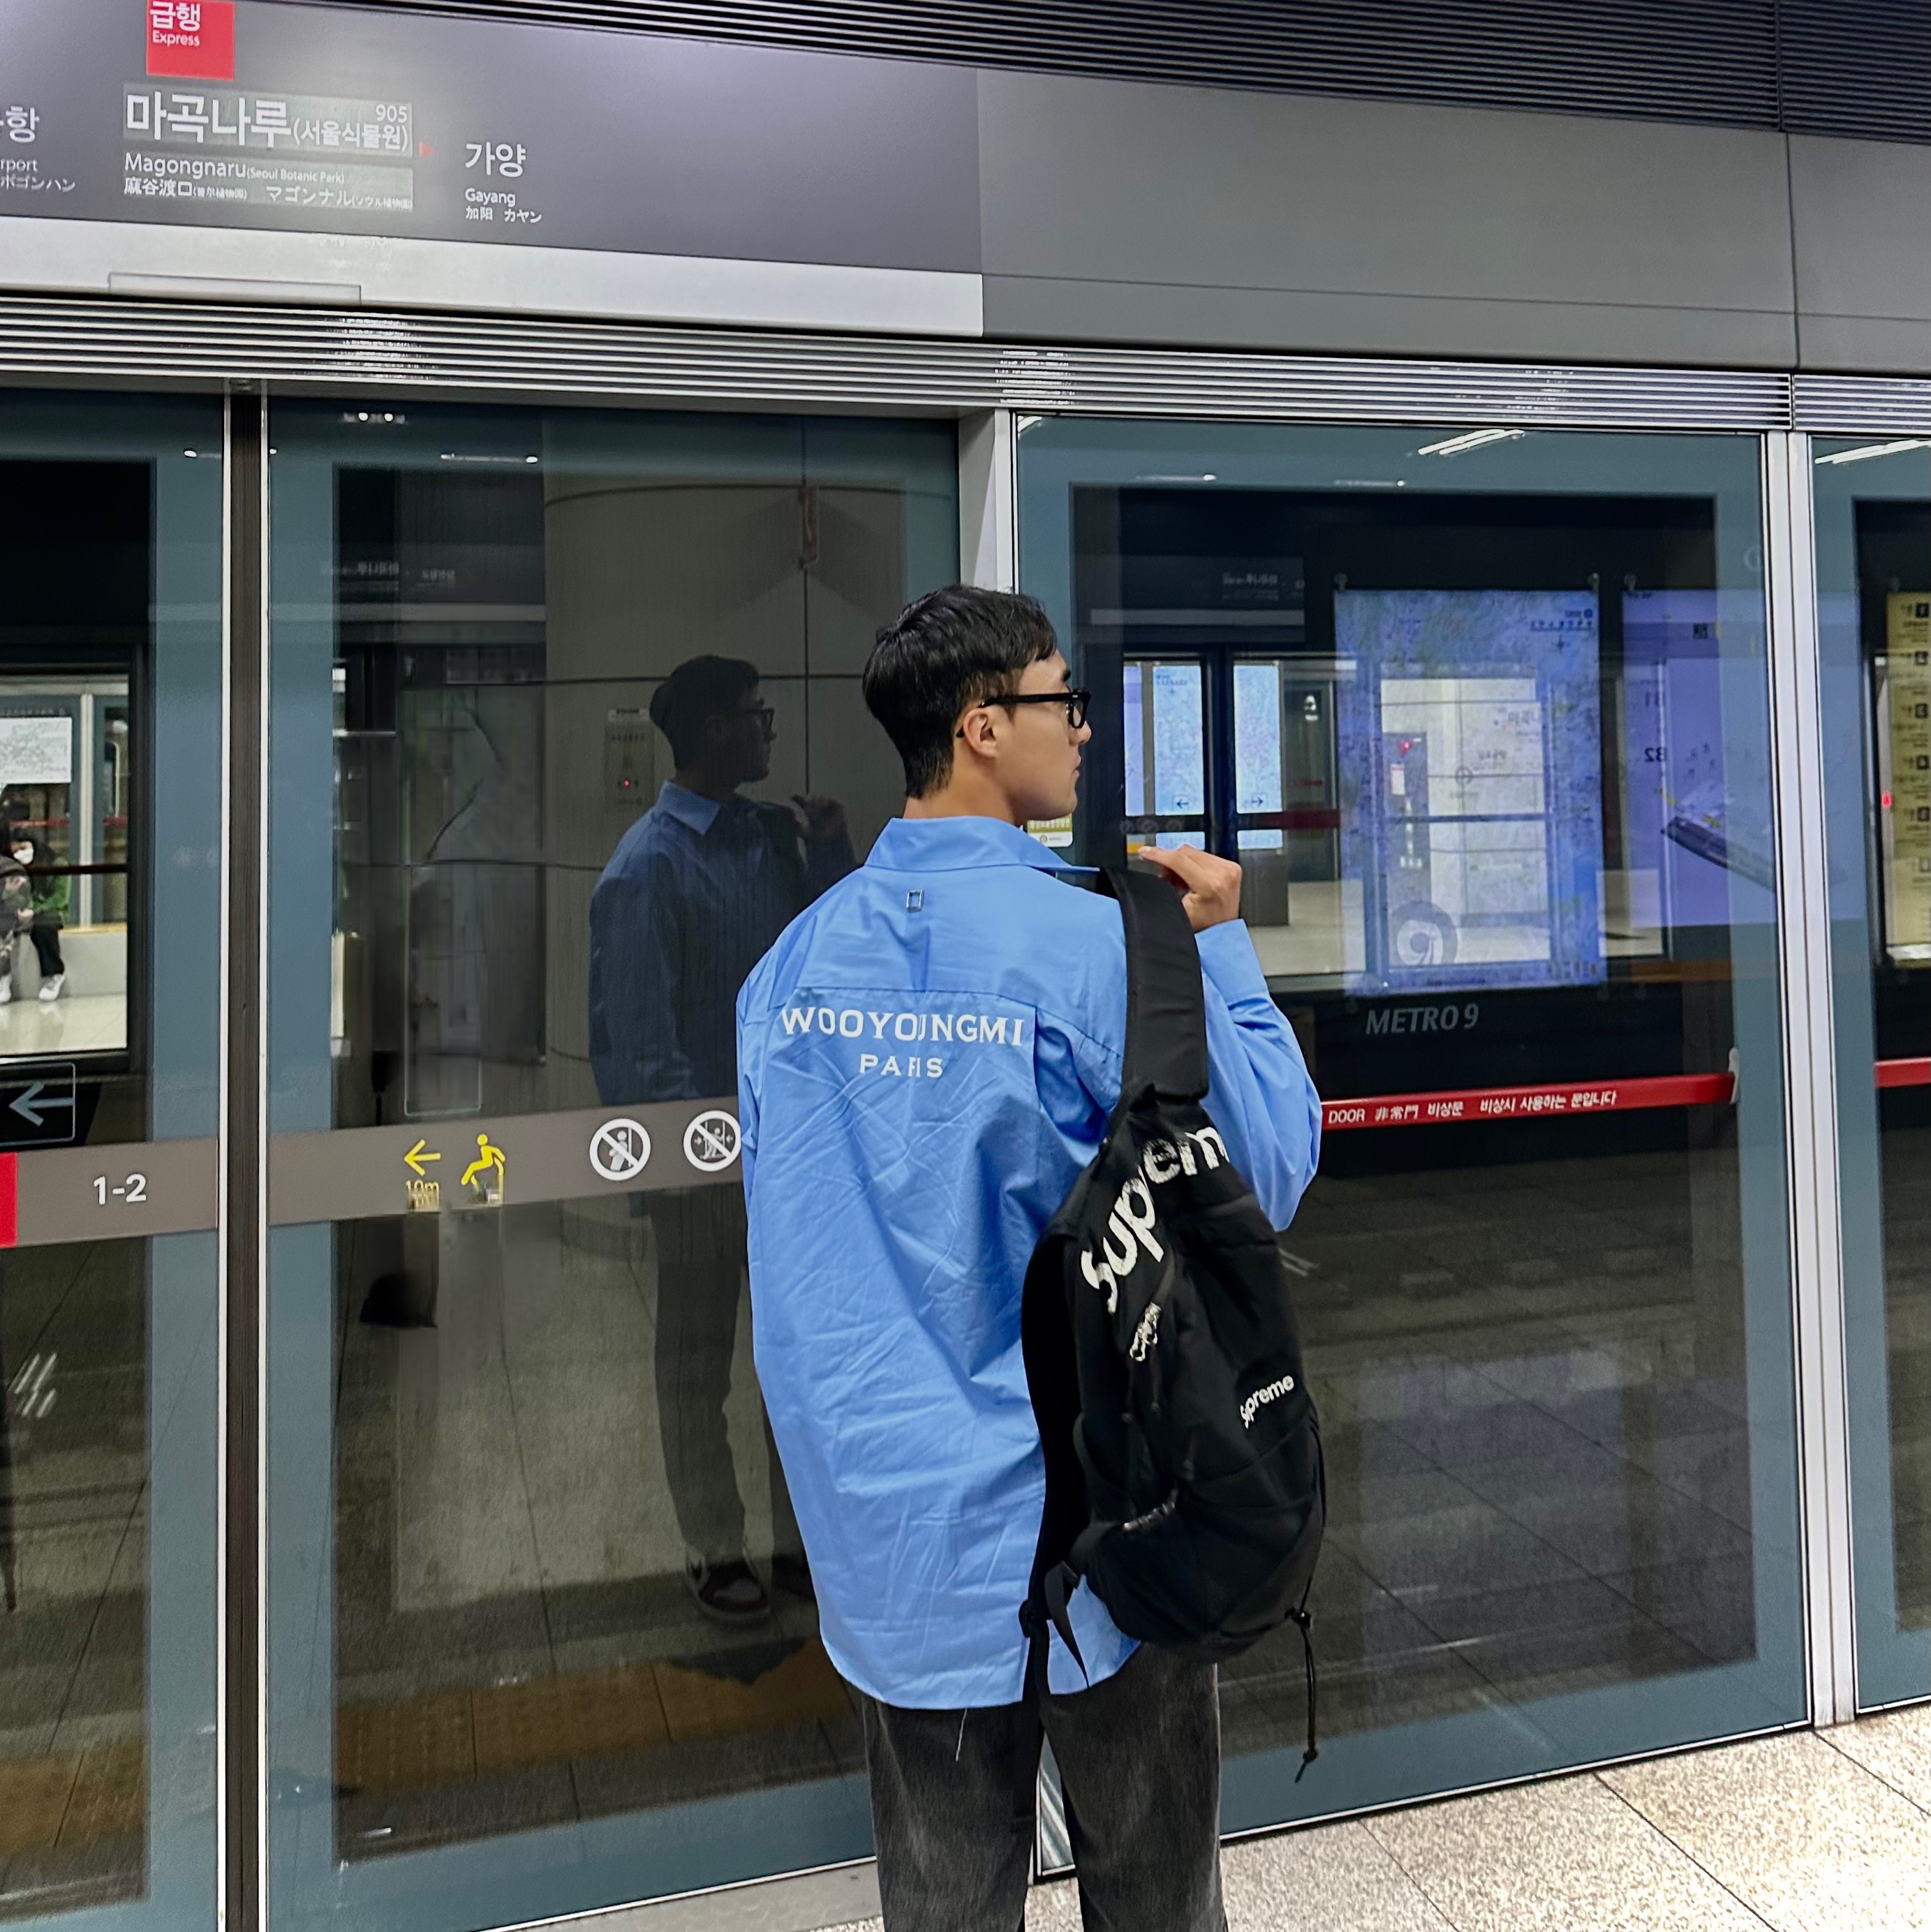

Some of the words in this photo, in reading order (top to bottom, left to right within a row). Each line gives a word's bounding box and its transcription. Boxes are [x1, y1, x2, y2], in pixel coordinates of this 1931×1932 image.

[149, 1, 201, 31] 급행
[152, 29, 200, 47] Express
[0, 105, 40, 143] 항
[375, 105, 408, 123] 905
[465, 142, 526, 178] 가양
[281, 168, 318, 181] Botanic
[320, 171, 346, 184] Park)
[465, 188, 516, 207] Gayang
[504, 209, 542, 223] カヤン
[1366, 1005, 1459, 1035] METRO
[1464, 1003, 1479, 1030] 9
[1328, 1108, 1366, 1124] DOOR
[1428, 1101, 1464, 1118] 비상문
[1480, 1097, 1516, 1114] 비상시
[1520, 1094, 1567, 1112] 사용하는
[1571, 1090, 1617, 1108] 문입니다
[94, 1173, 147, 1205] 1-2
